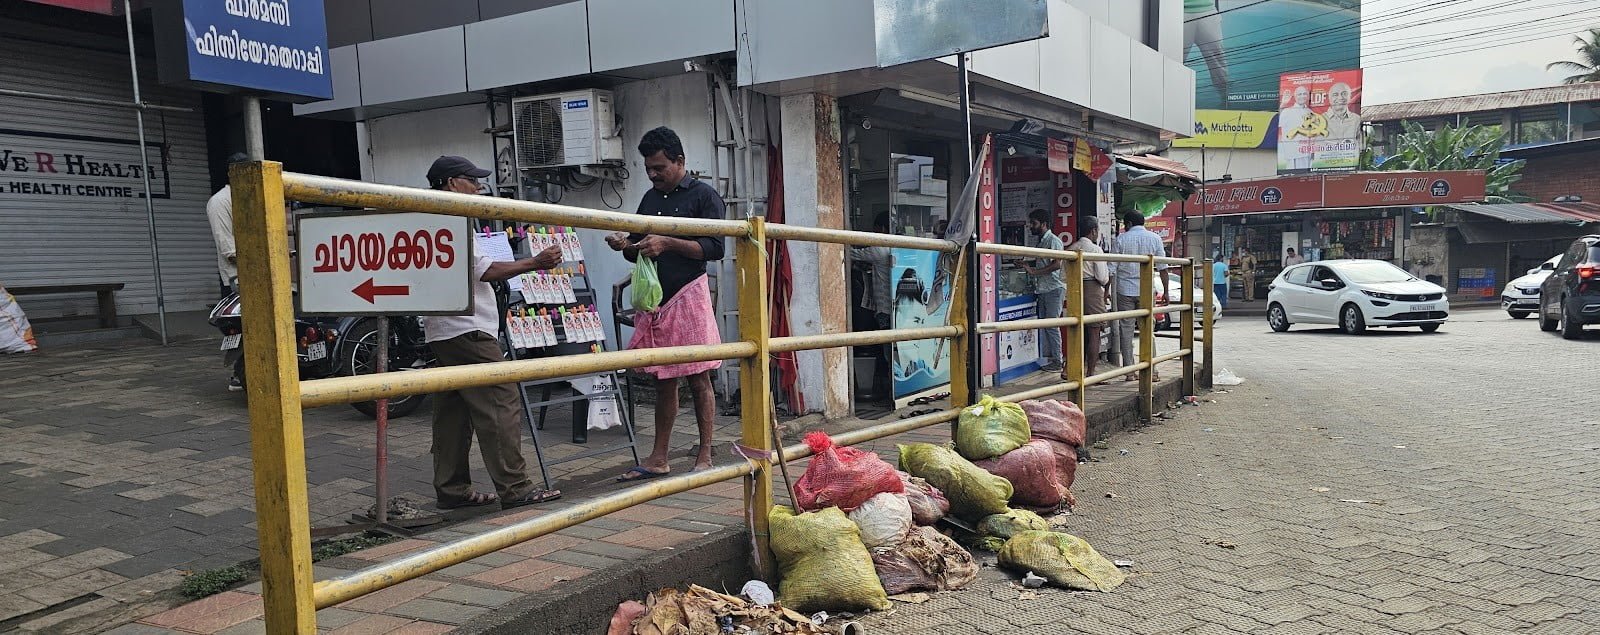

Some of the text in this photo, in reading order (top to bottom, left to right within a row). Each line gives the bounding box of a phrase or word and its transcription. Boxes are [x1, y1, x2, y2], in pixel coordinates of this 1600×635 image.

[195, 24, 324, 75] ഫിസിയോതെറാപ്പി
[1311, 92, 1327, 104] LDF
[1211, 122, 1253, 132] Muthoottu
[34, 152, 58, 174] R
[9, 181, 133, 198] HEALTH CENTRE
[1363, 177, 1428, 193] Full Fill
[1194, 186, 1259, 205] Full Fill
[313, 228, 455, 273] ചായക്കട
